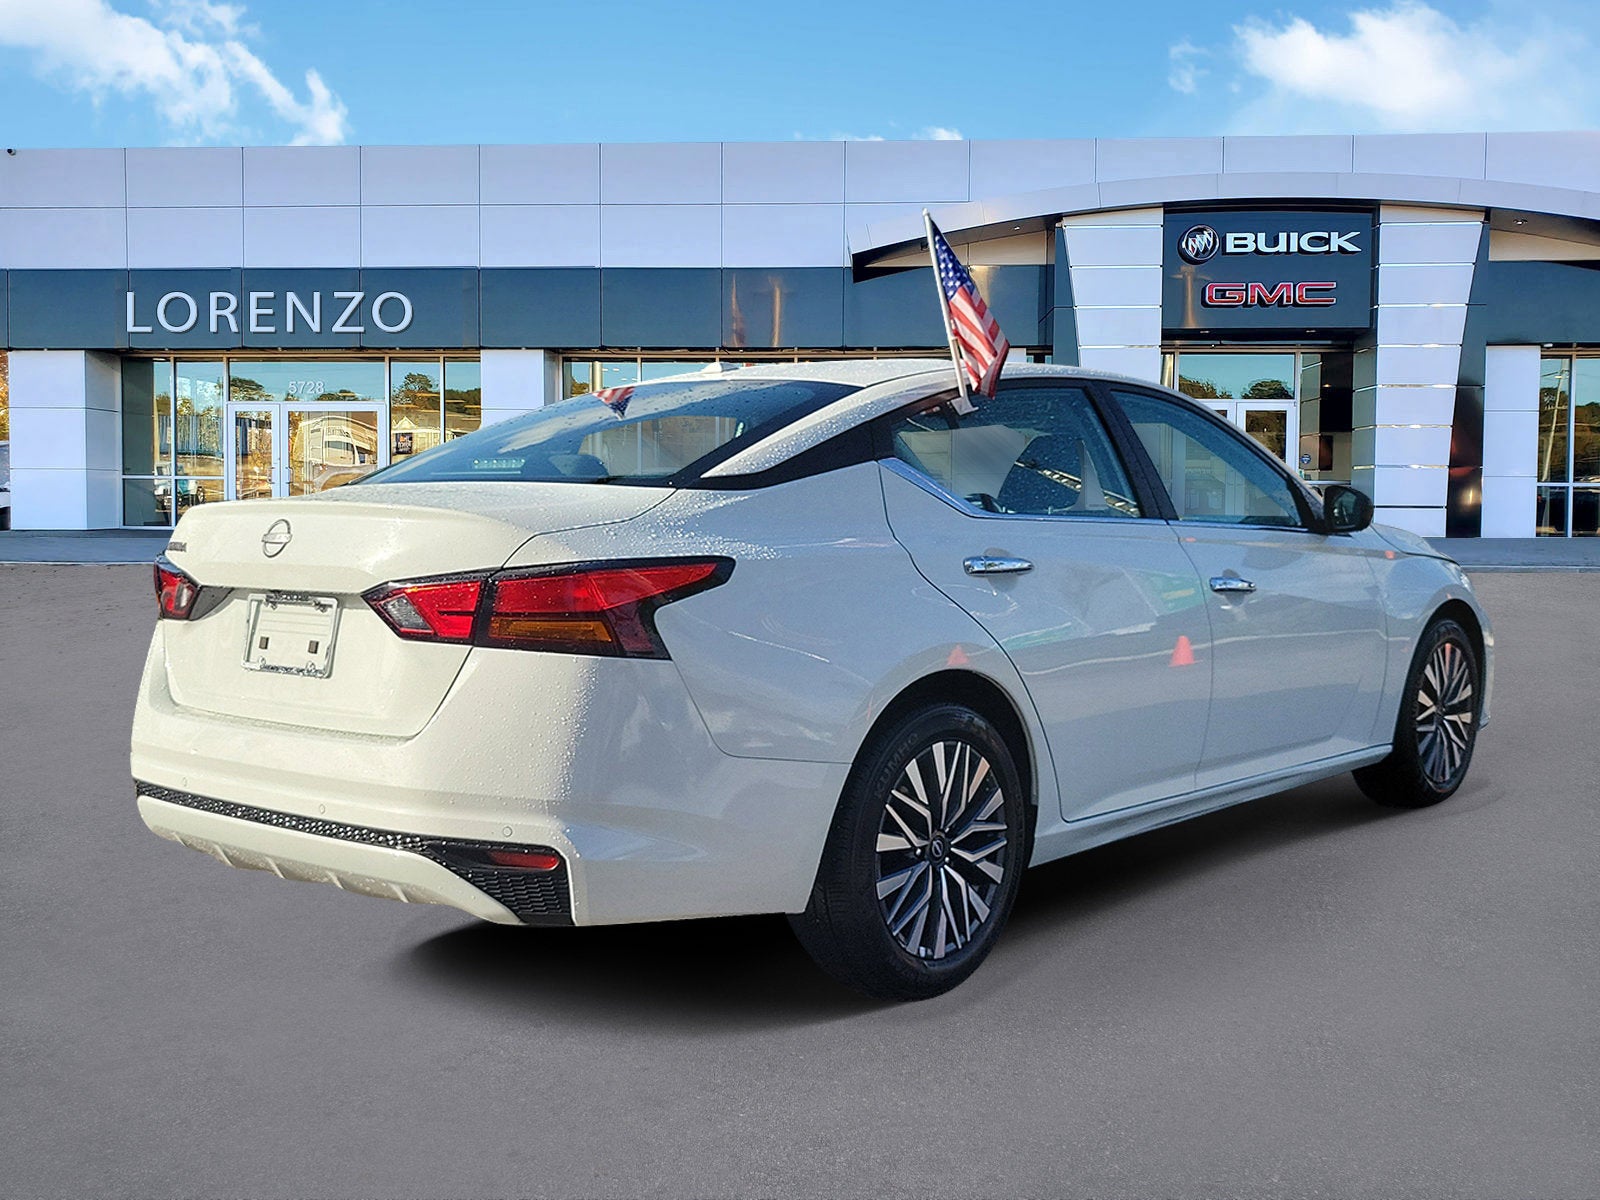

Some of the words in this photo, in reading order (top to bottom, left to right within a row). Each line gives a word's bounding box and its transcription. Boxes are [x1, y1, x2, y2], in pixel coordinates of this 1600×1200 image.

[1225, 231, 1362, 254] BUICK
[1204, 281, 1337, 305] GMC
[126, 290, 414, 334] LORENZO
[288, 380, 326, 395] 5728
